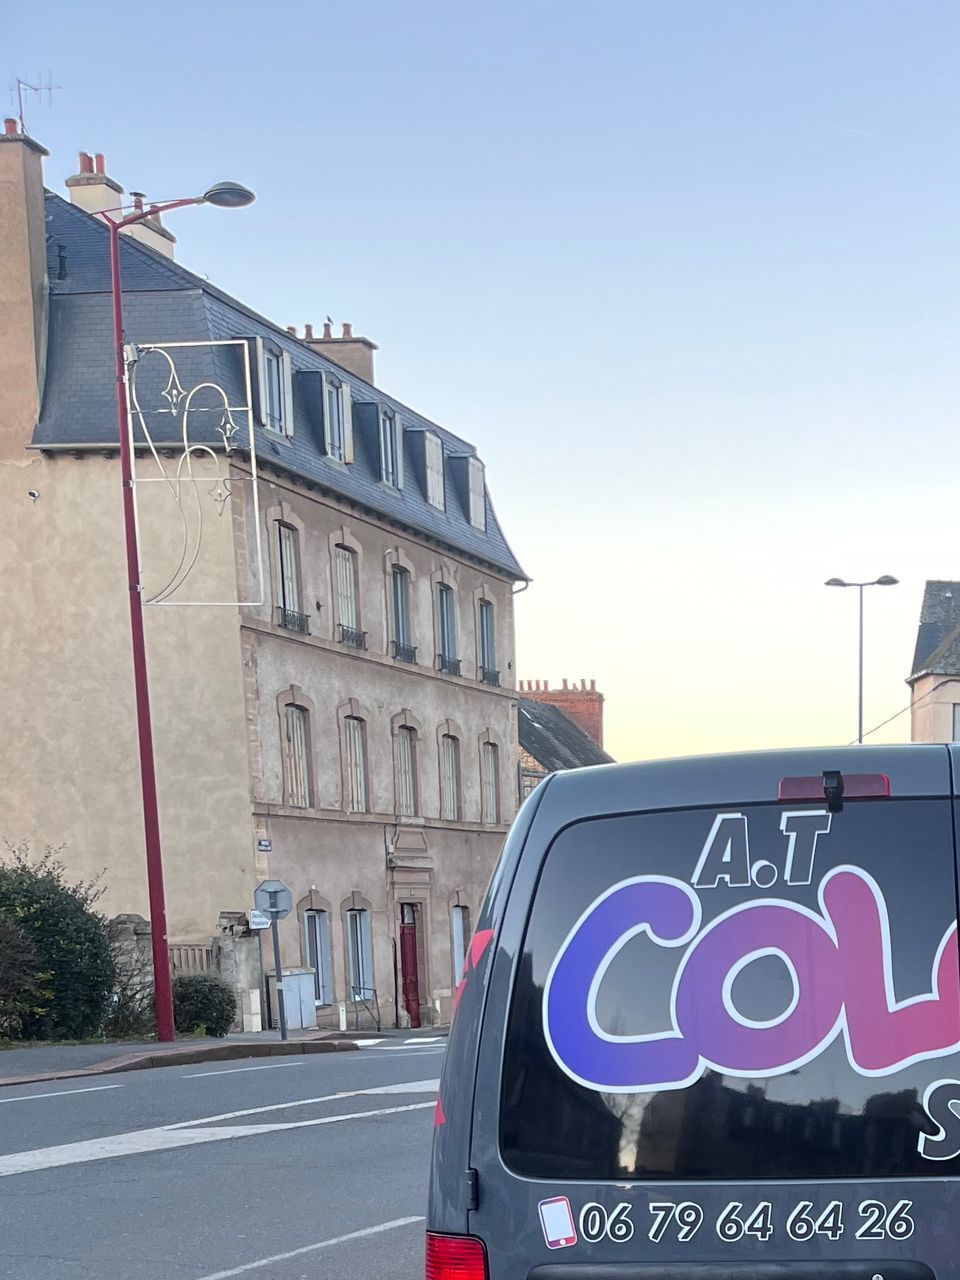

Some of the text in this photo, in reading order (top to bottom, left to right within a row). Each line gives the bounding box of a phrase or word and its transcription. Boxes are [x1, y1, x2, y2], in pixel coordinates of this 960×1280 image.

[691, 810, 832, 888] A.T
[579, 1200, 915, 1243] 06 79 64 64 26
